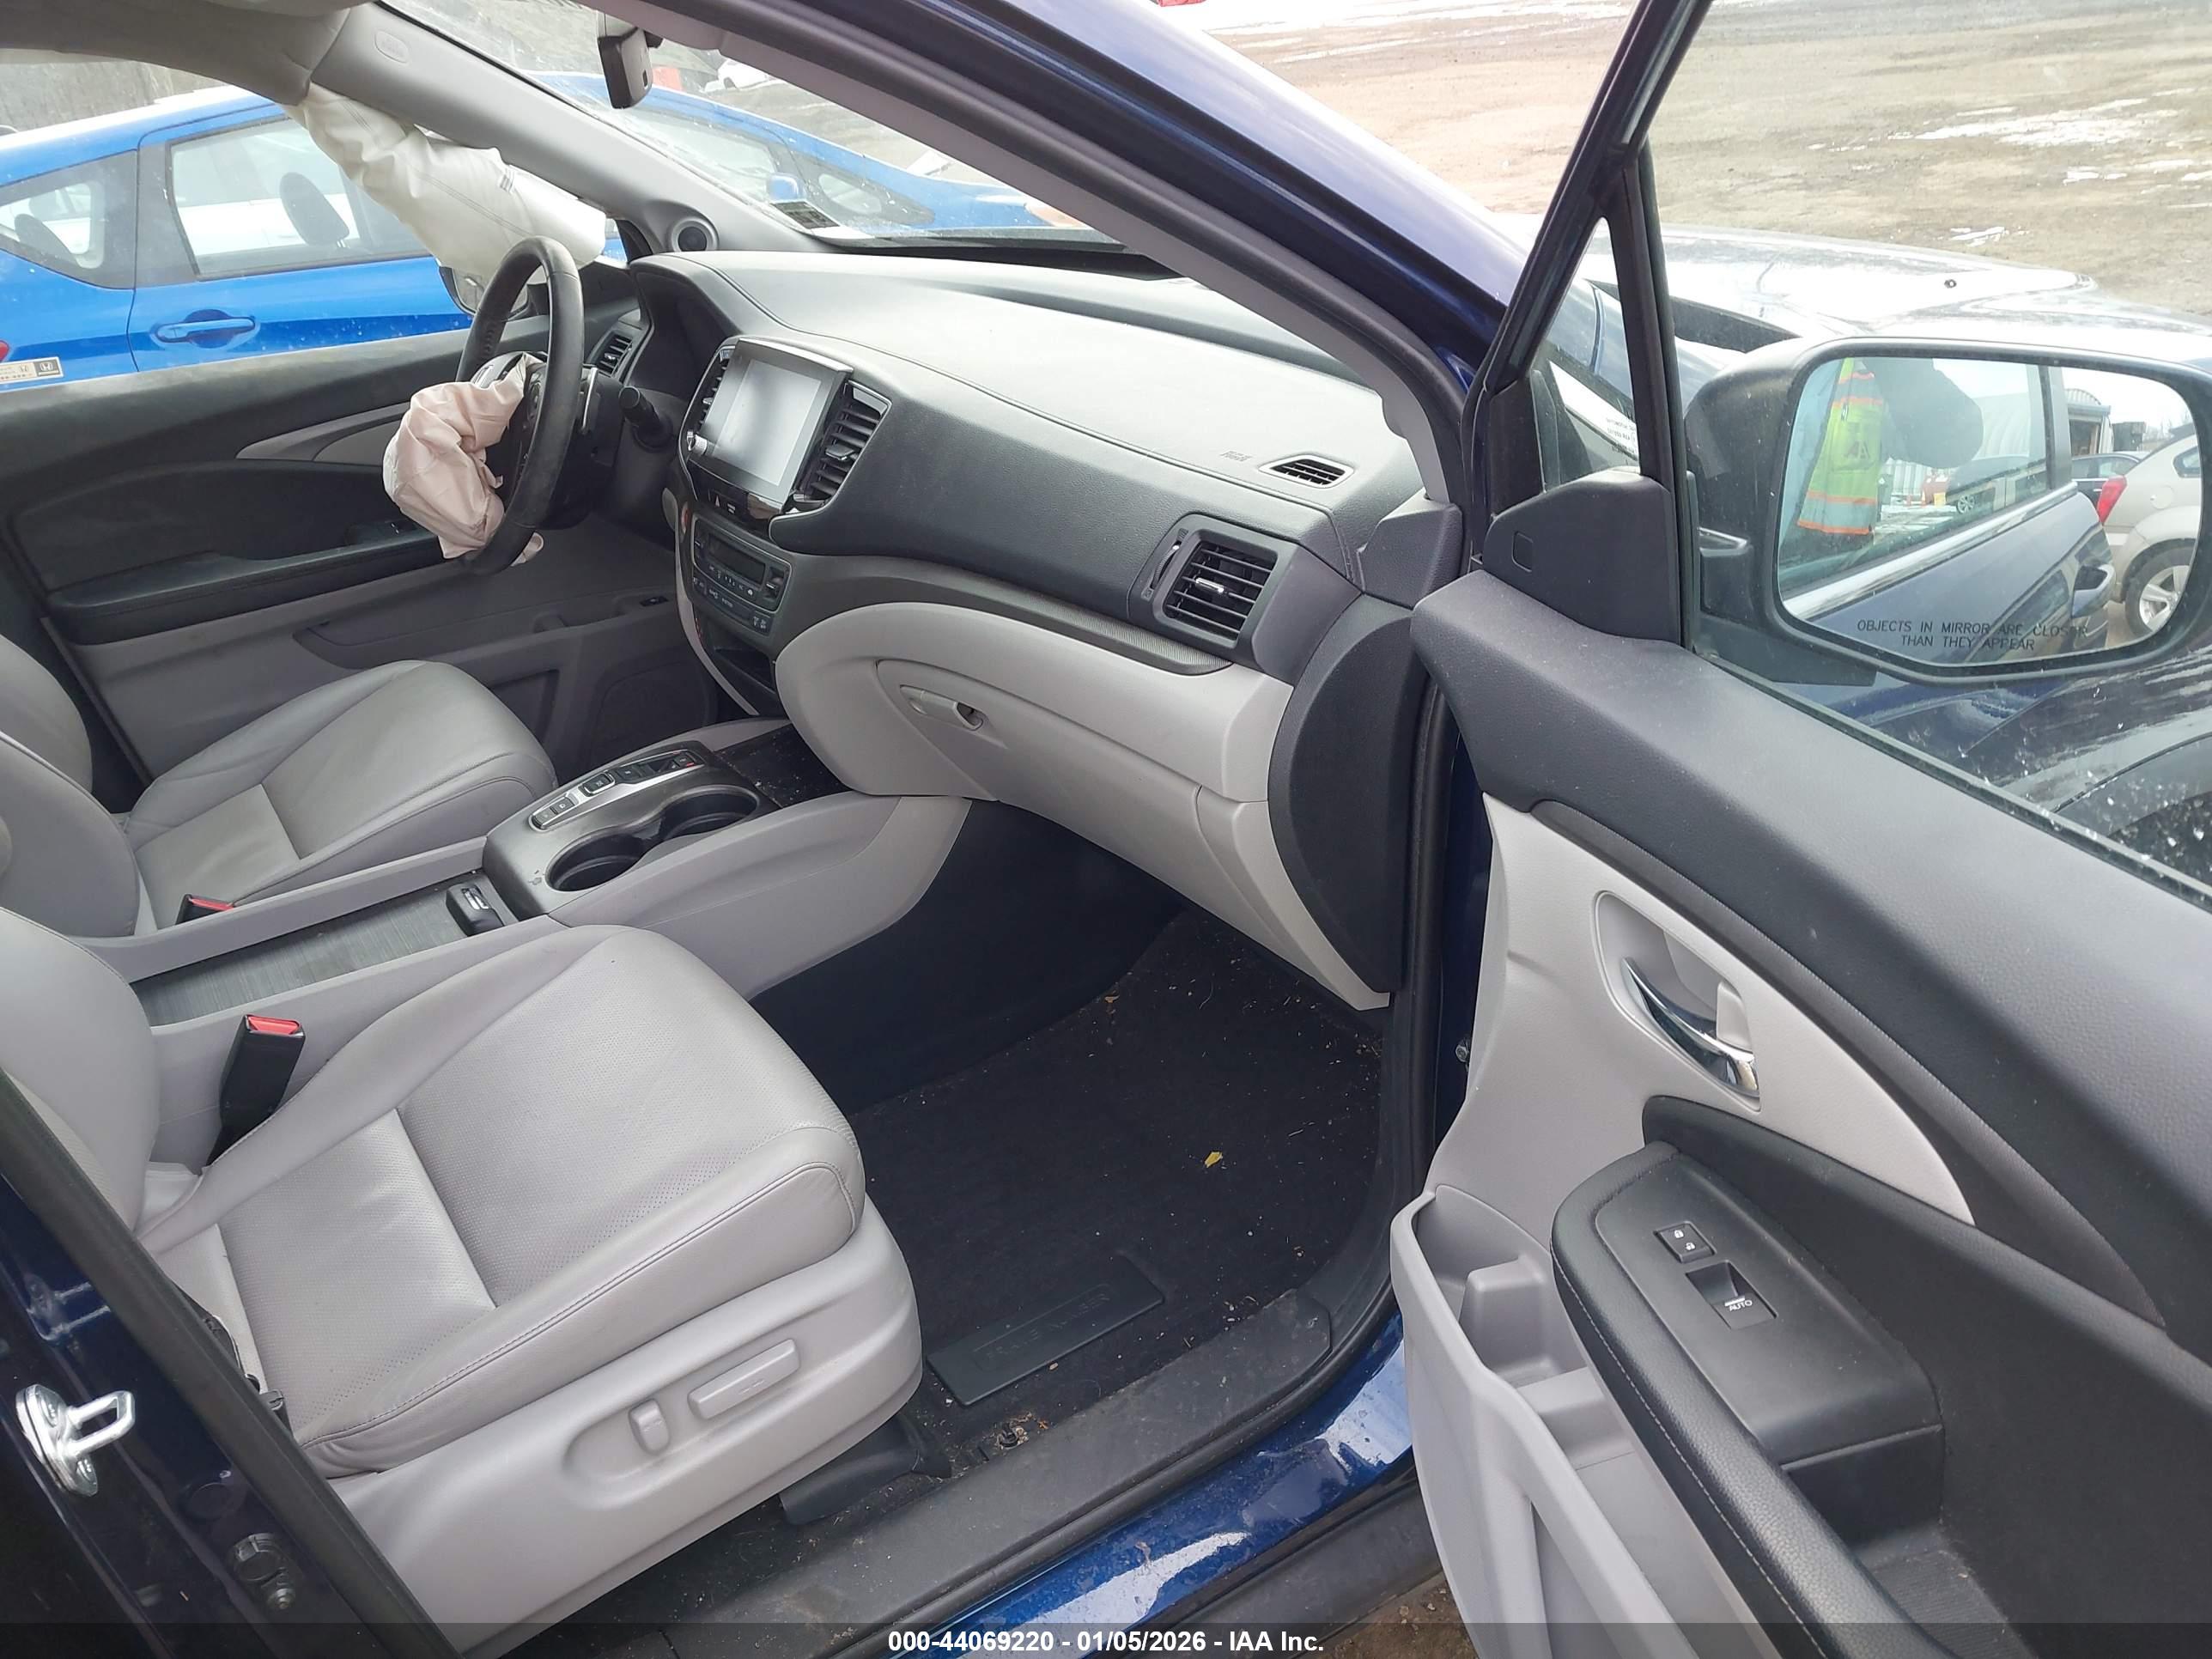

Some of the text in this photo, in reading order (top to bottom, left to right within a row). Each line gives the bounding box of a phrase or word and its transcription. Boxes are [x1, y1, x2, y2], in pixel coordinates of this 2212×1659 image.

[1856, 619, 1911, 632] OBJECTS
[1920, 621, 1933, 633] IN
[1941, 622, 1990, 635] MIRROR
[1998, 624, 2023, 635] ARE
[1901, 635, 2035, 650] THAN THEY APPEAR
[1729, 1299, 1753, 1311] AUTO
